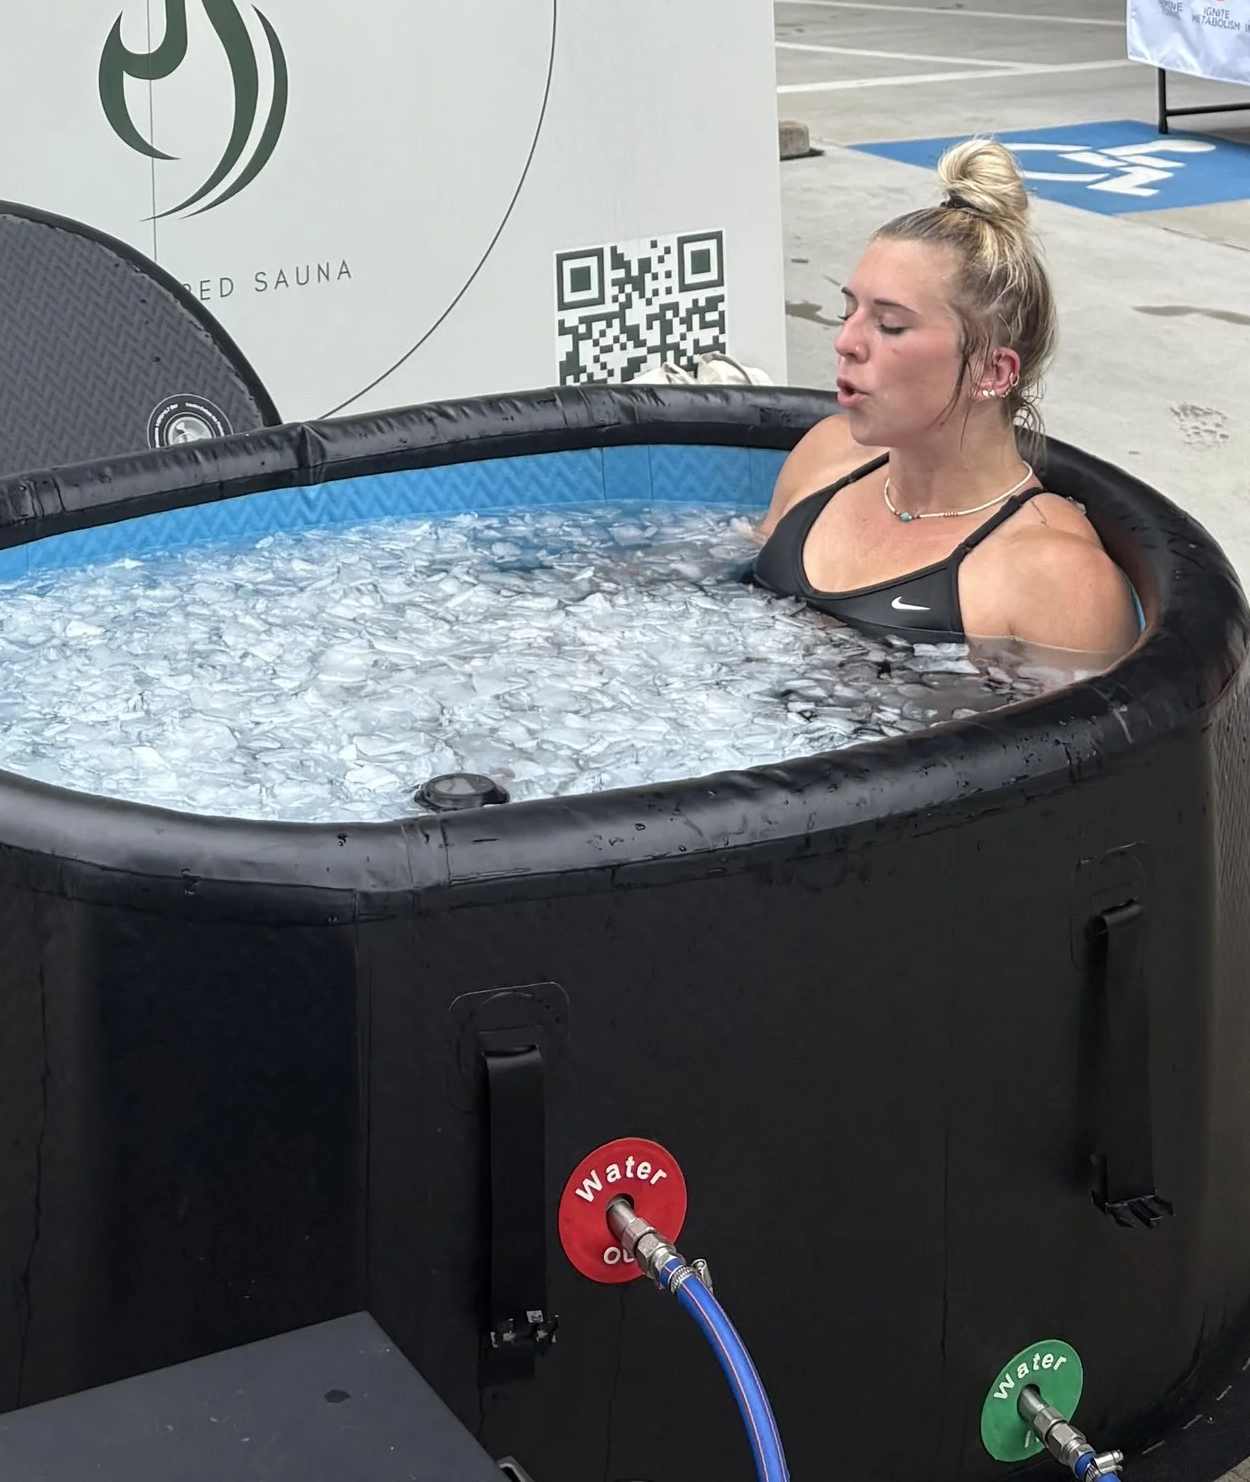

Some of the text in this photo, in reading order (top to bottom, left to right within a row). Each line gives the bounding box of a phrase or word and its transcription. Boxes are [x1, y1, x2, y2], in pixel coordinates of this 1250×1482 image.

[1204, 6, 1230, 19] IGNITE
[254, 259, 352, 292] SAUNA
[575, 1155, 667, 1203] Water
[993, 1353, 1067, 1400] Water
